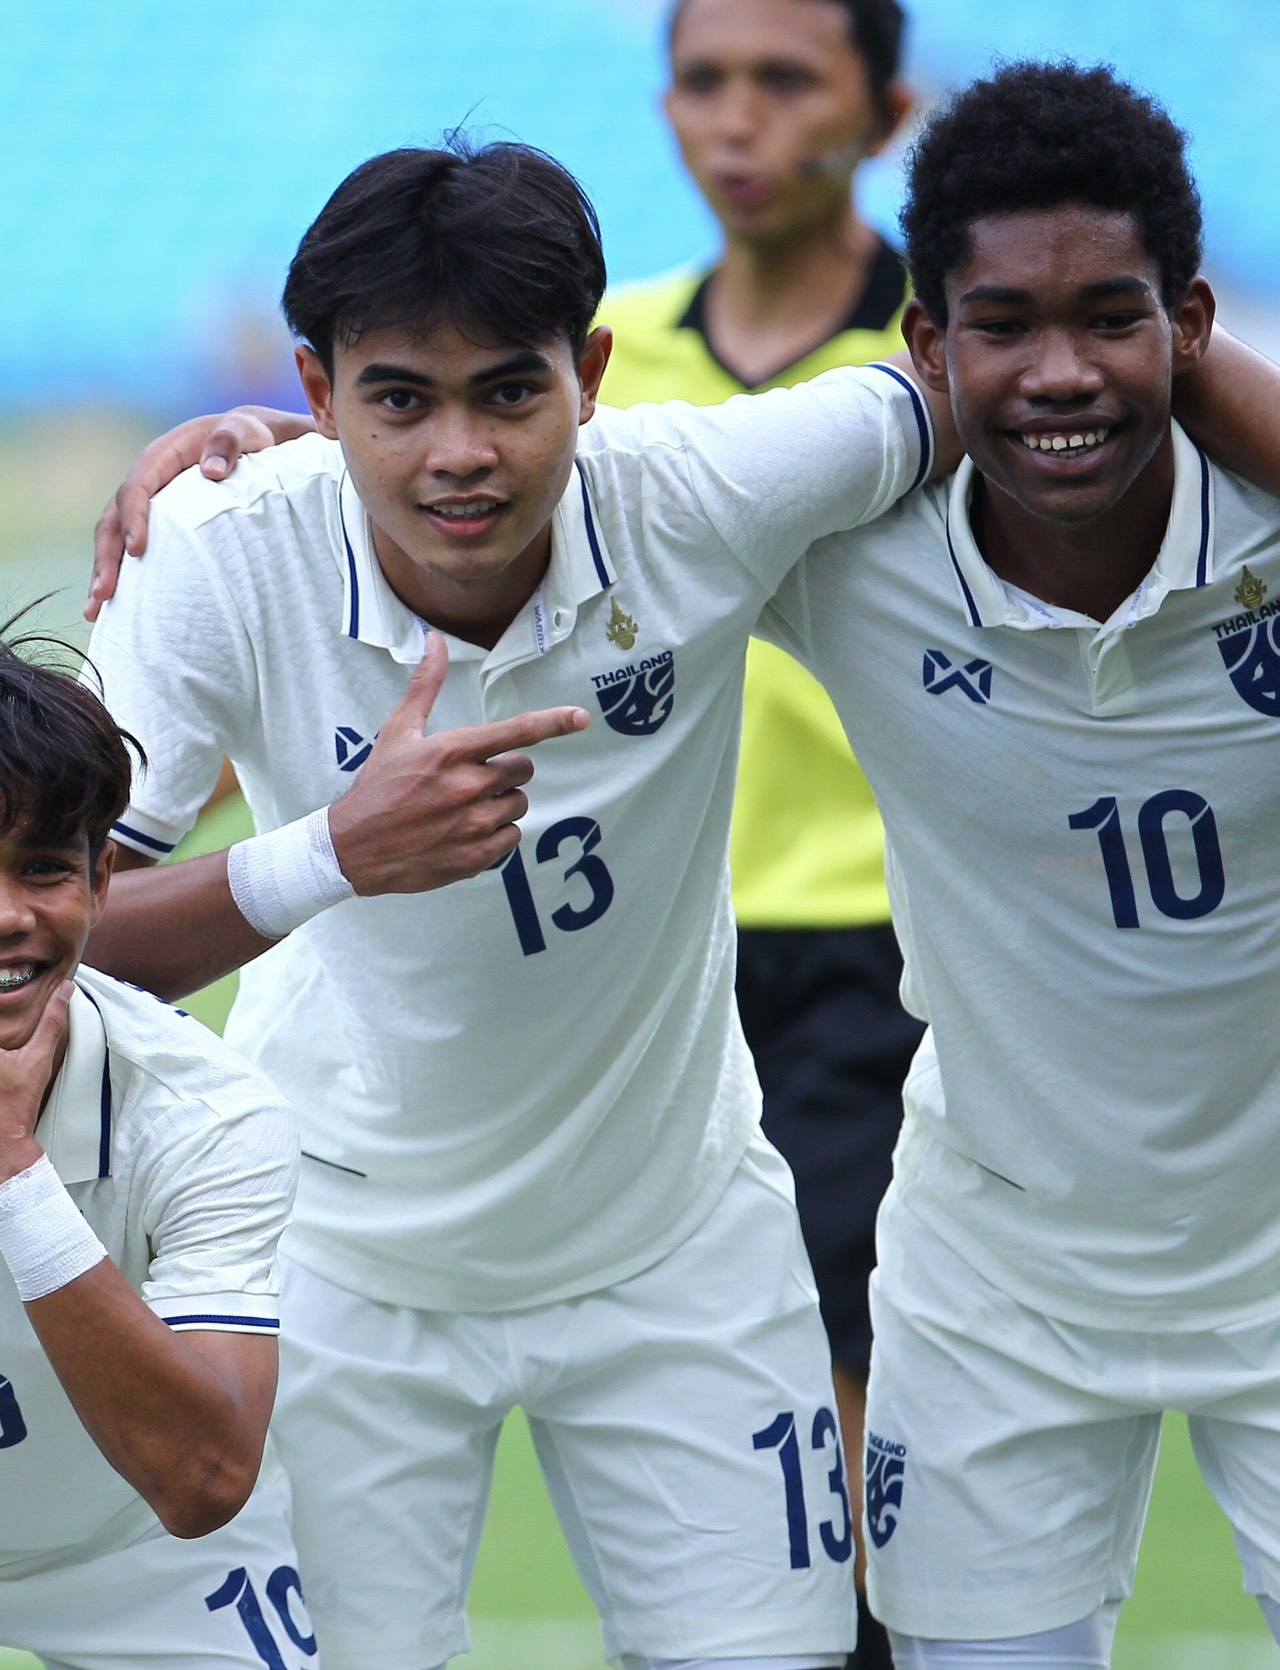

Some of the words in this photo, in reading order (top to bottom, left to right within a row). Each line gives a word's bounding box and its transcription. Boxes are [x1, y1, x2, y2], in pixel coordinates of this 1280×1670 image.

[591, 650, 673, 689] THAILAND
[1211, 599, 1280, 638] THAILAN
[484, 816, 614, 957] 13
[1068, 789, 1225, 928] 10
[752, 1405, 853, 1569] 13
[204, 1565, 317, 1670] 19
